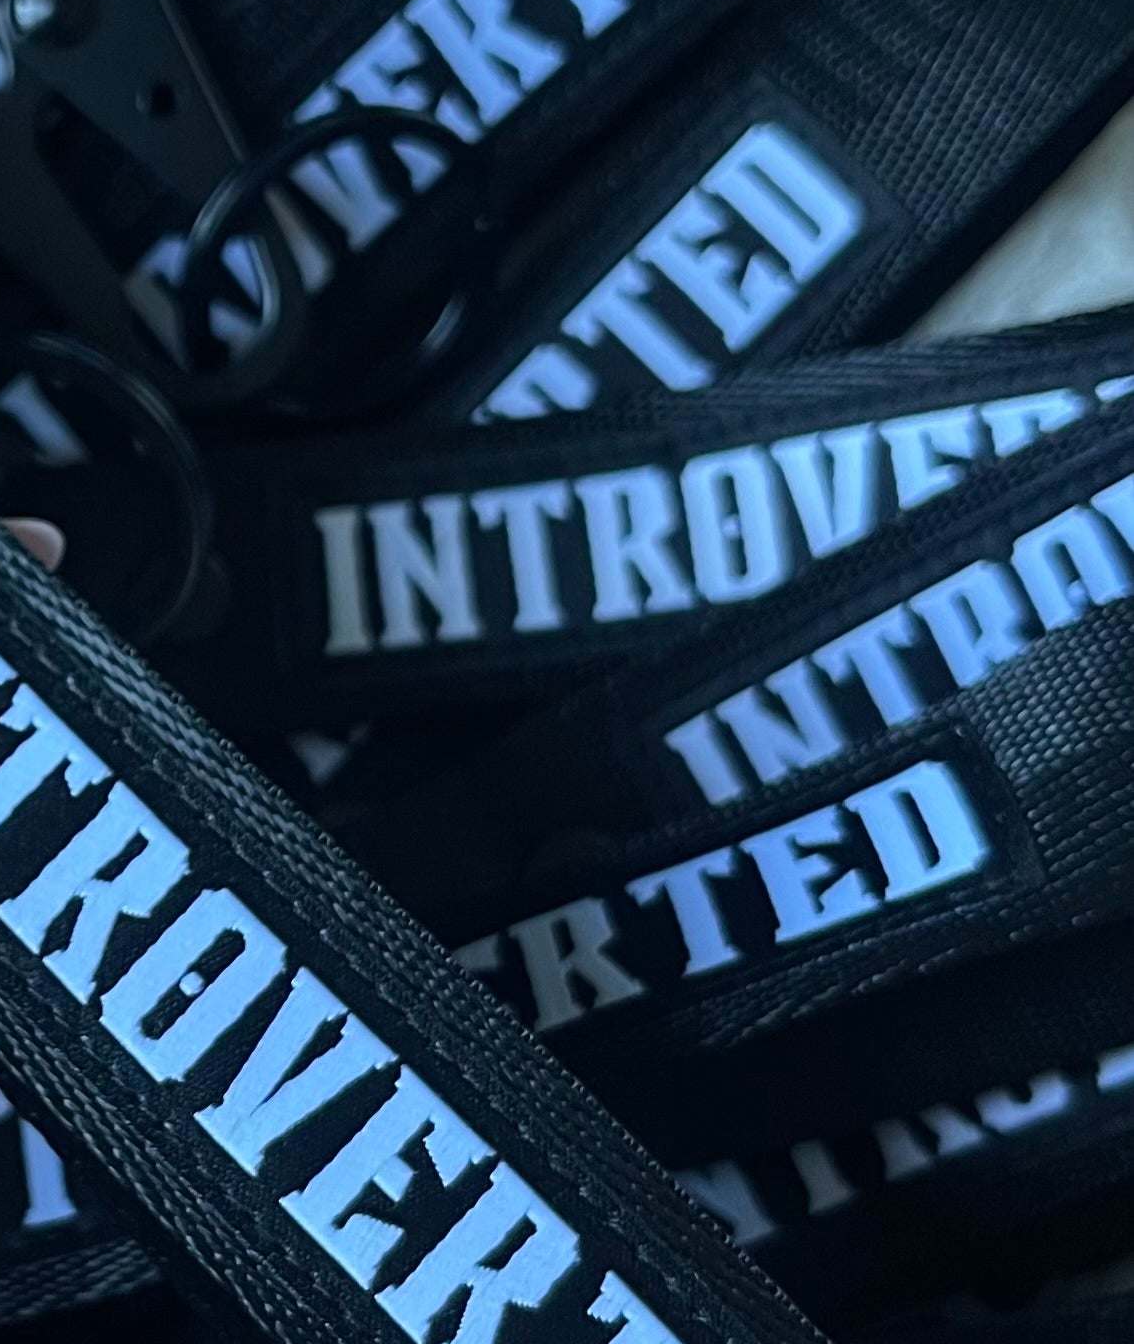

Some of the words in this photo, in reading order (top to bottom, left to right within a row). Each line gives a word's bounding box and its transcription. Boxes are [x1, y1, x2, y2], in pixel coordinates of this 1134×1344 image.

[312, 374, 1134, 654] INTROVE
[666, 470, 1134, 806] INTRO
[456, 760, 992, 1031] RTED
